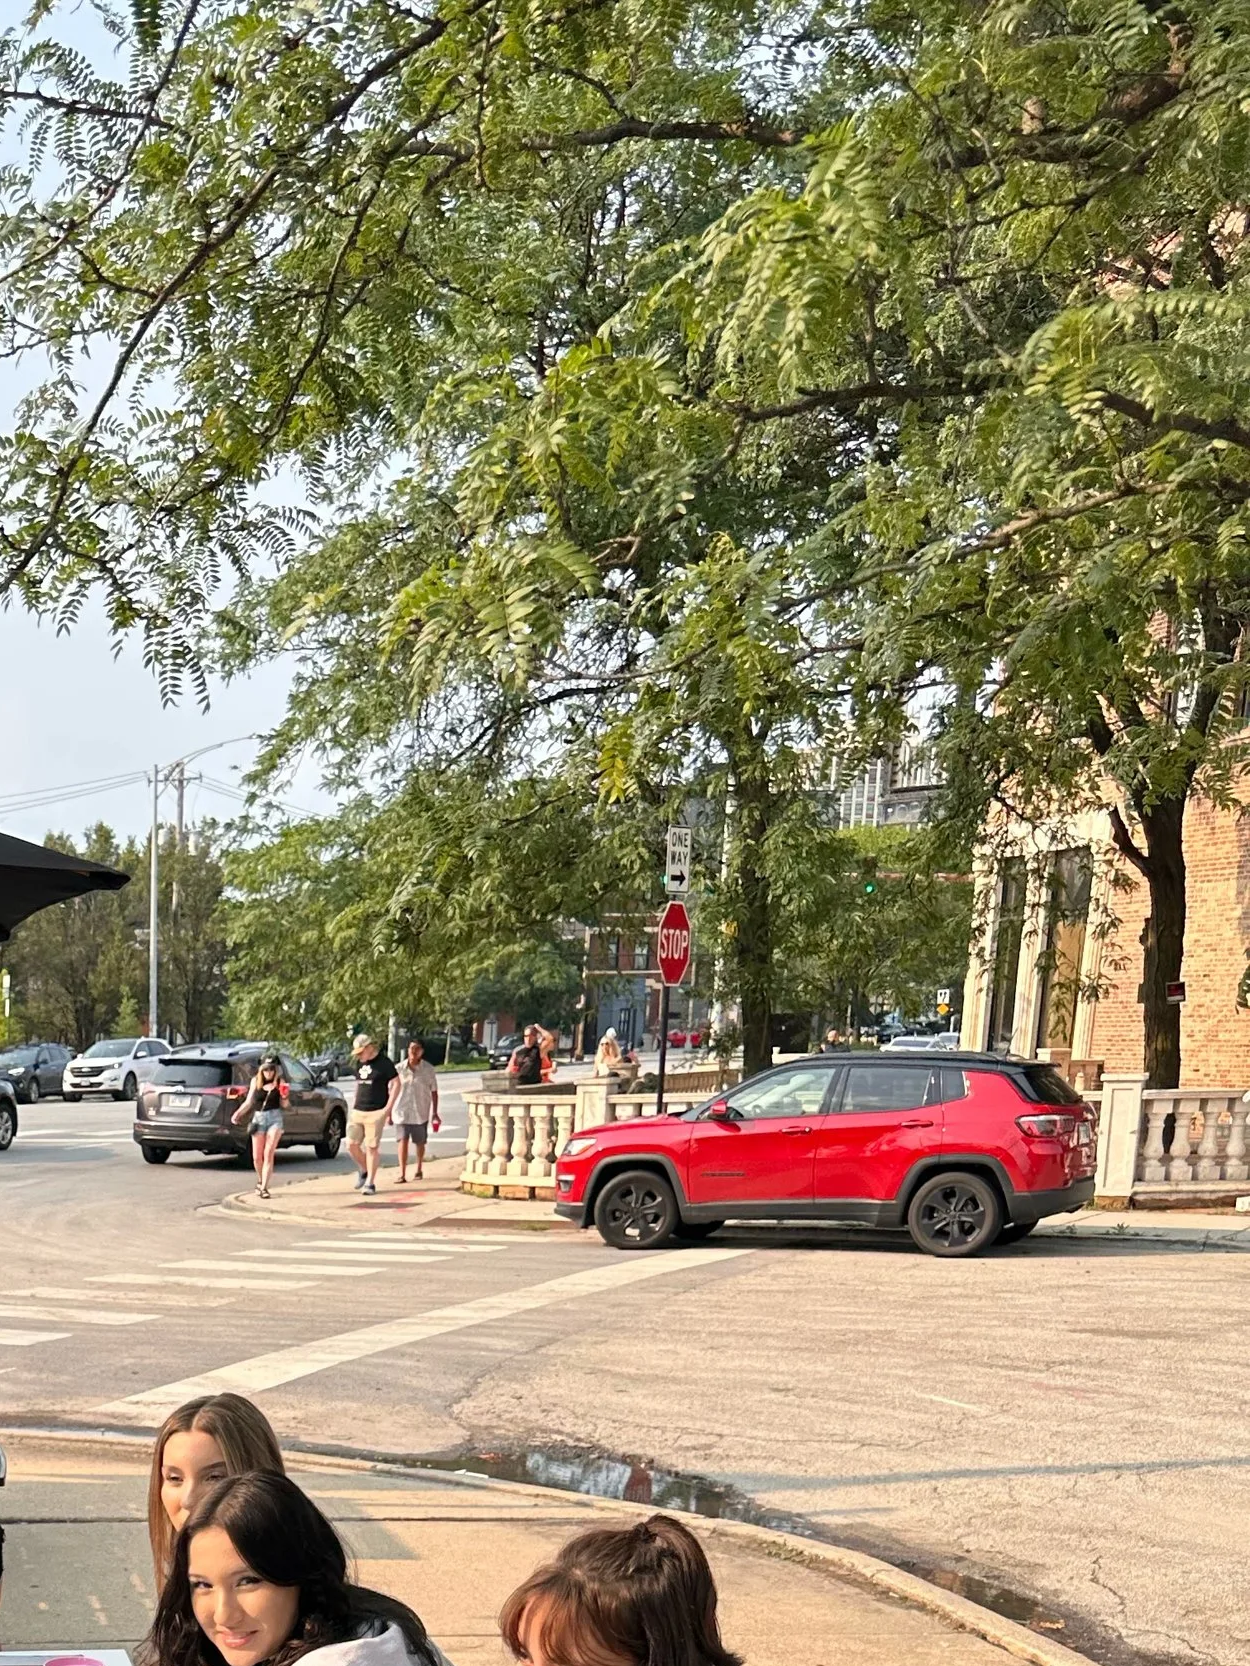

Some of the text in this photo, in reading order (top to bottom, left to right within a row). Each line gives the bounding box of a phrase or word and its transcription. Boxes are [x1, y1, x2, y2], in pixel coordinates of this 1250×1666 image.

[671, 832, 689, 848] ONE
[670, 851, 689, 866] WAY
[660, 929, 689, 960] STOP
